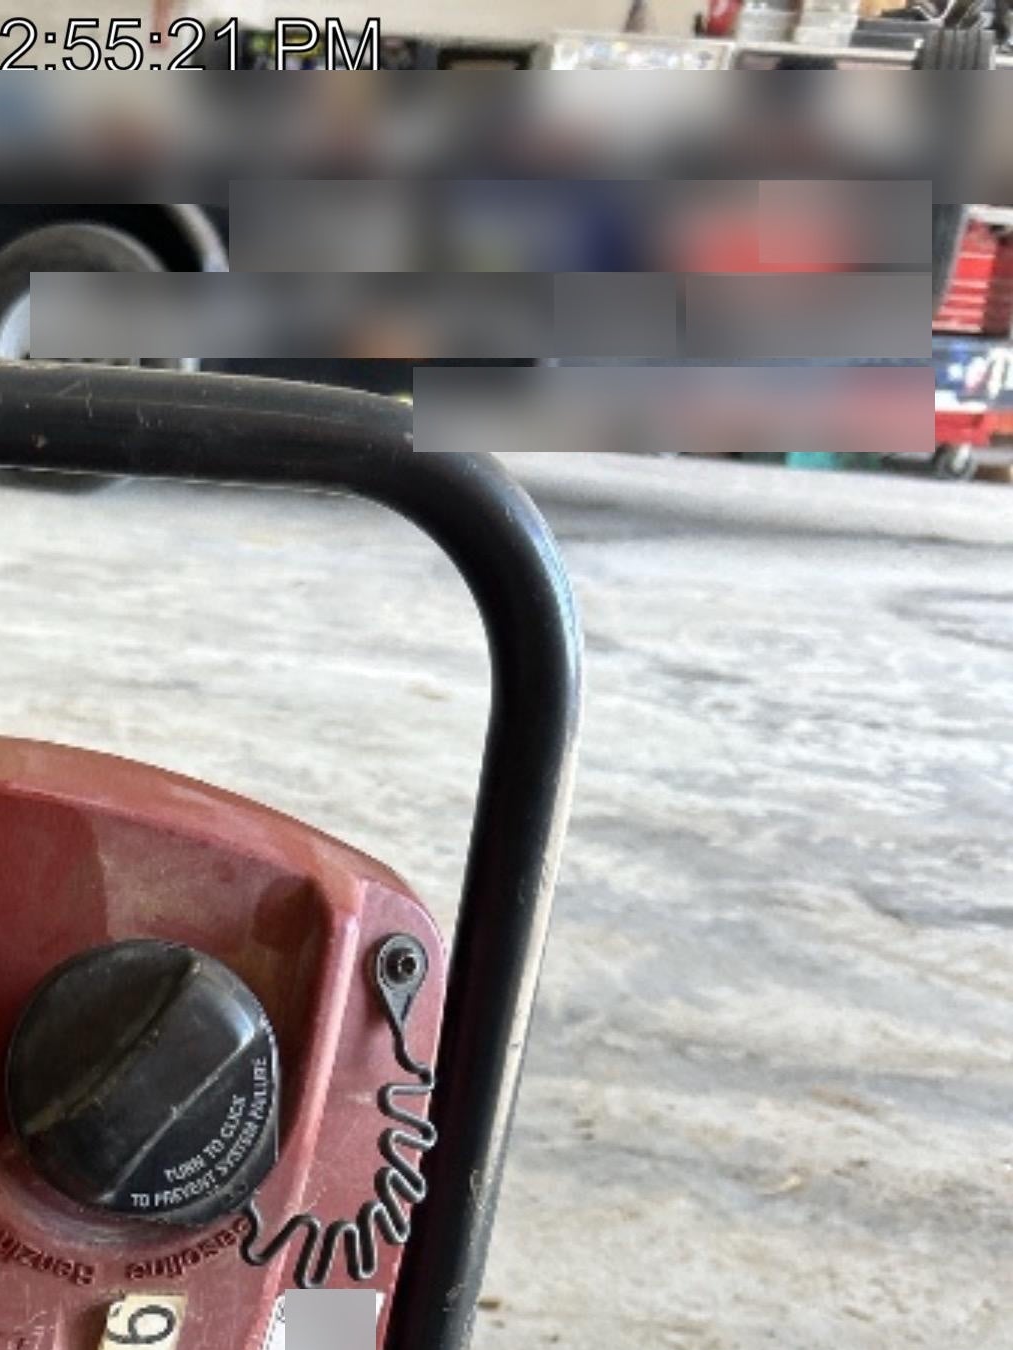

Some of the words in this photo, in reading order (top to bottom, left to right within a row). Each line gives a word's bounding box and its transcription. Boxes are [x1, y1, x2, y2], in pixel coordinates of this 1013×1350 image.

[130, 1193, 150, 1209] TO
[154, 1169, 216, 1207] PREVENT
[215, 1121, 259, 1177] SYSTEM
[248, 1056, 268, 1121] FAILURE
[163, 1154, 206, 1182] TURN
[203, 1138, 225, 1160] TO
[220, 1094, 246, 1139] CLICK
